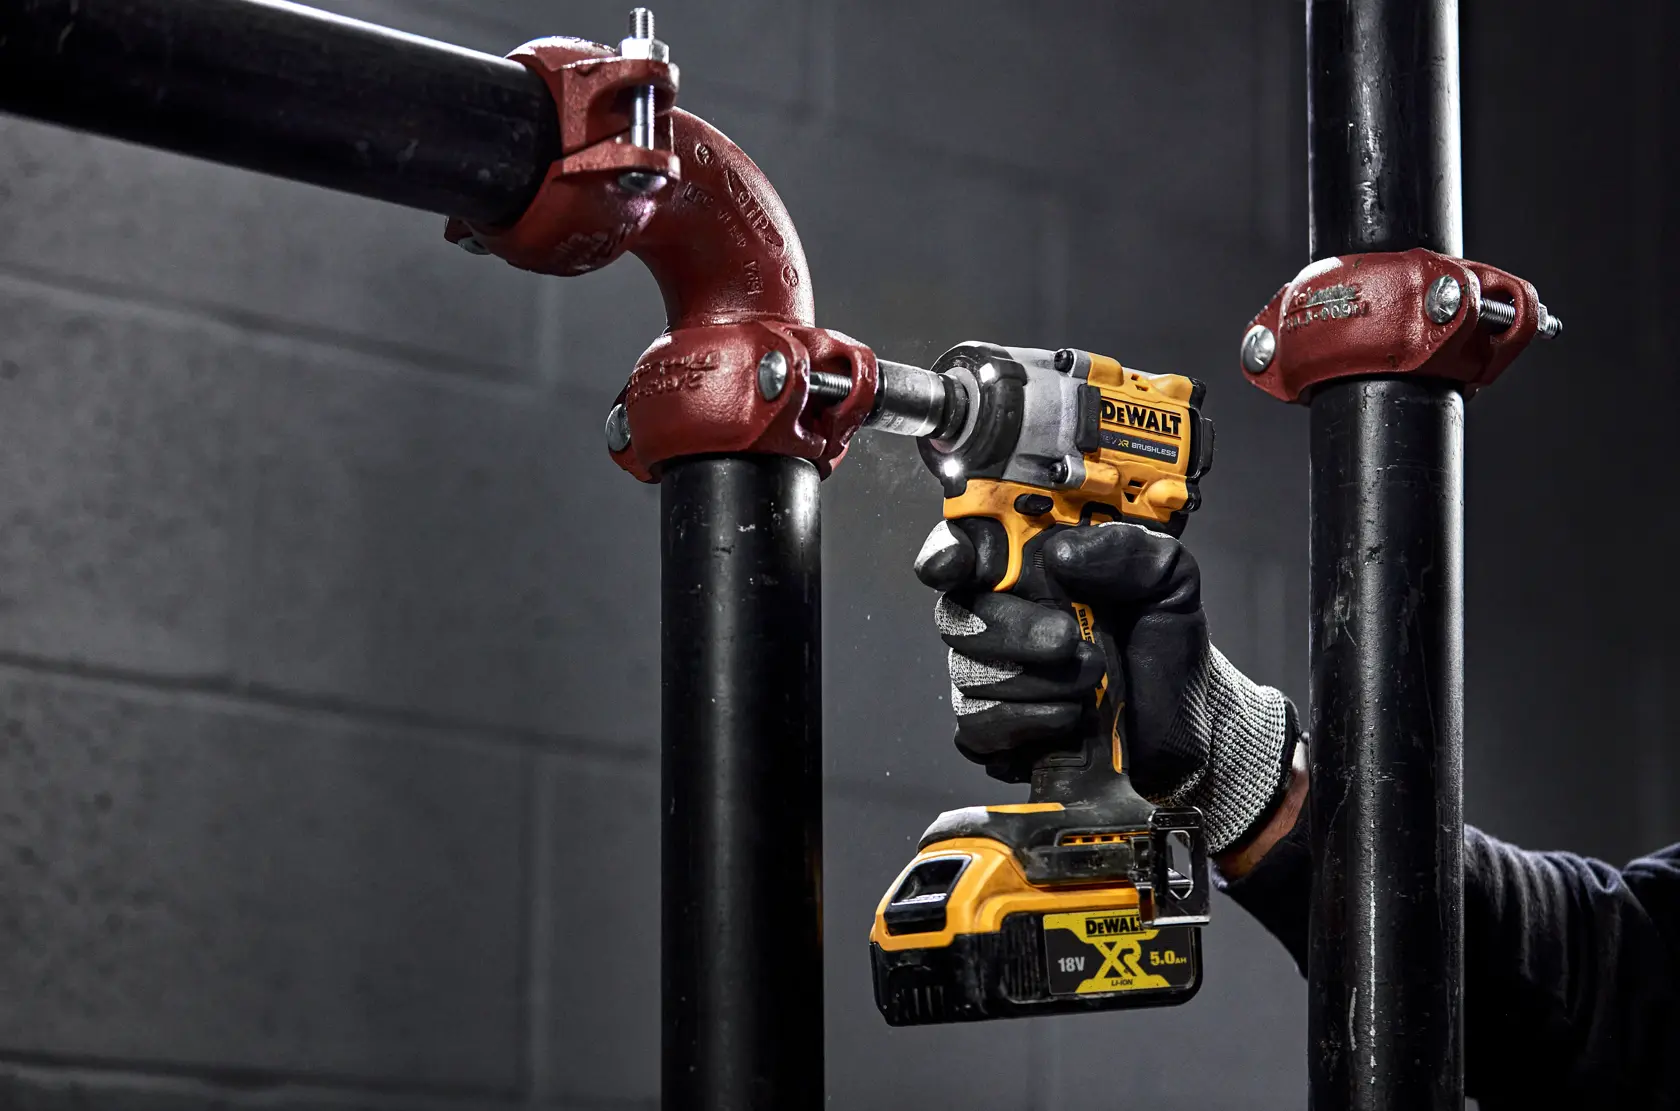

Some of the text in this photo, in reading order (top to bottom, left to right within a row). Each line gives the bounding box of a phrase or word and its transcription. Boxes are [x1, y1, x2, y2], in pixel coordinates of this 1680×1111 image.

[1101, 401, 1181, 434] DEWALT
[1118, 439, 1129, 447] XR
[1131, 443, 1177, 457] BRUSHLESS
[1058, 957, 1085, 972] 18V
[1094, 940, 1149, 979] XR
